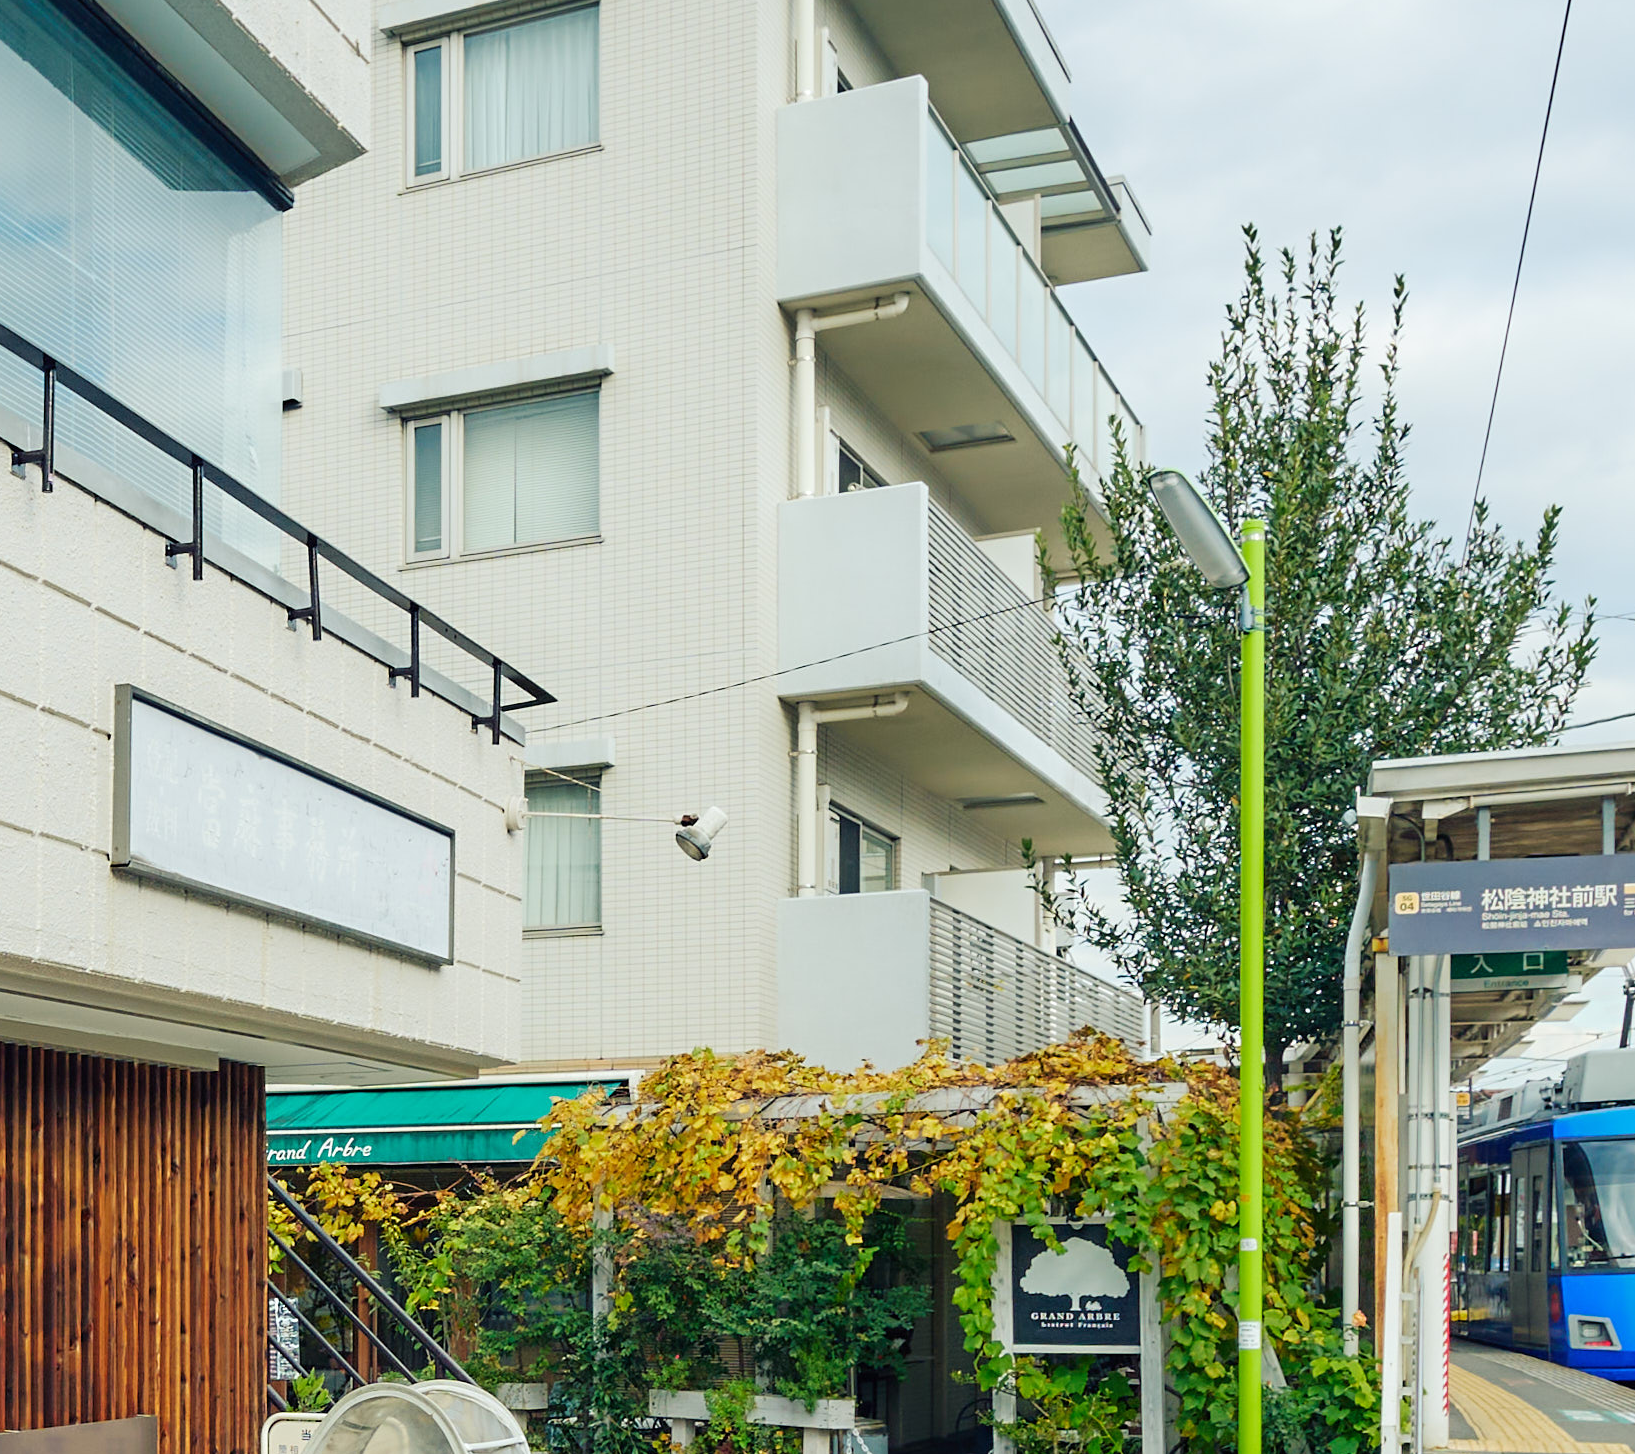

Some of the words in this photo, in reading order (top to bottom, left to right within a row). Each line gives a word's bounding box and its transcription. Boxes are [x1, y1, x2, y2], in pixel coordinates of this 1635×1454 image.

[1399, 902, 1415, 911] 04
[1481, 884, 1618, 912] 松陰神社前駅
[265, 1139, 312, 1162] rand
[316, 1136, 372, 1159] Arbre
[1030, 1312, 1074, 1321] GRAND
[1078, 1312, 1121, 1321] ARBRE
